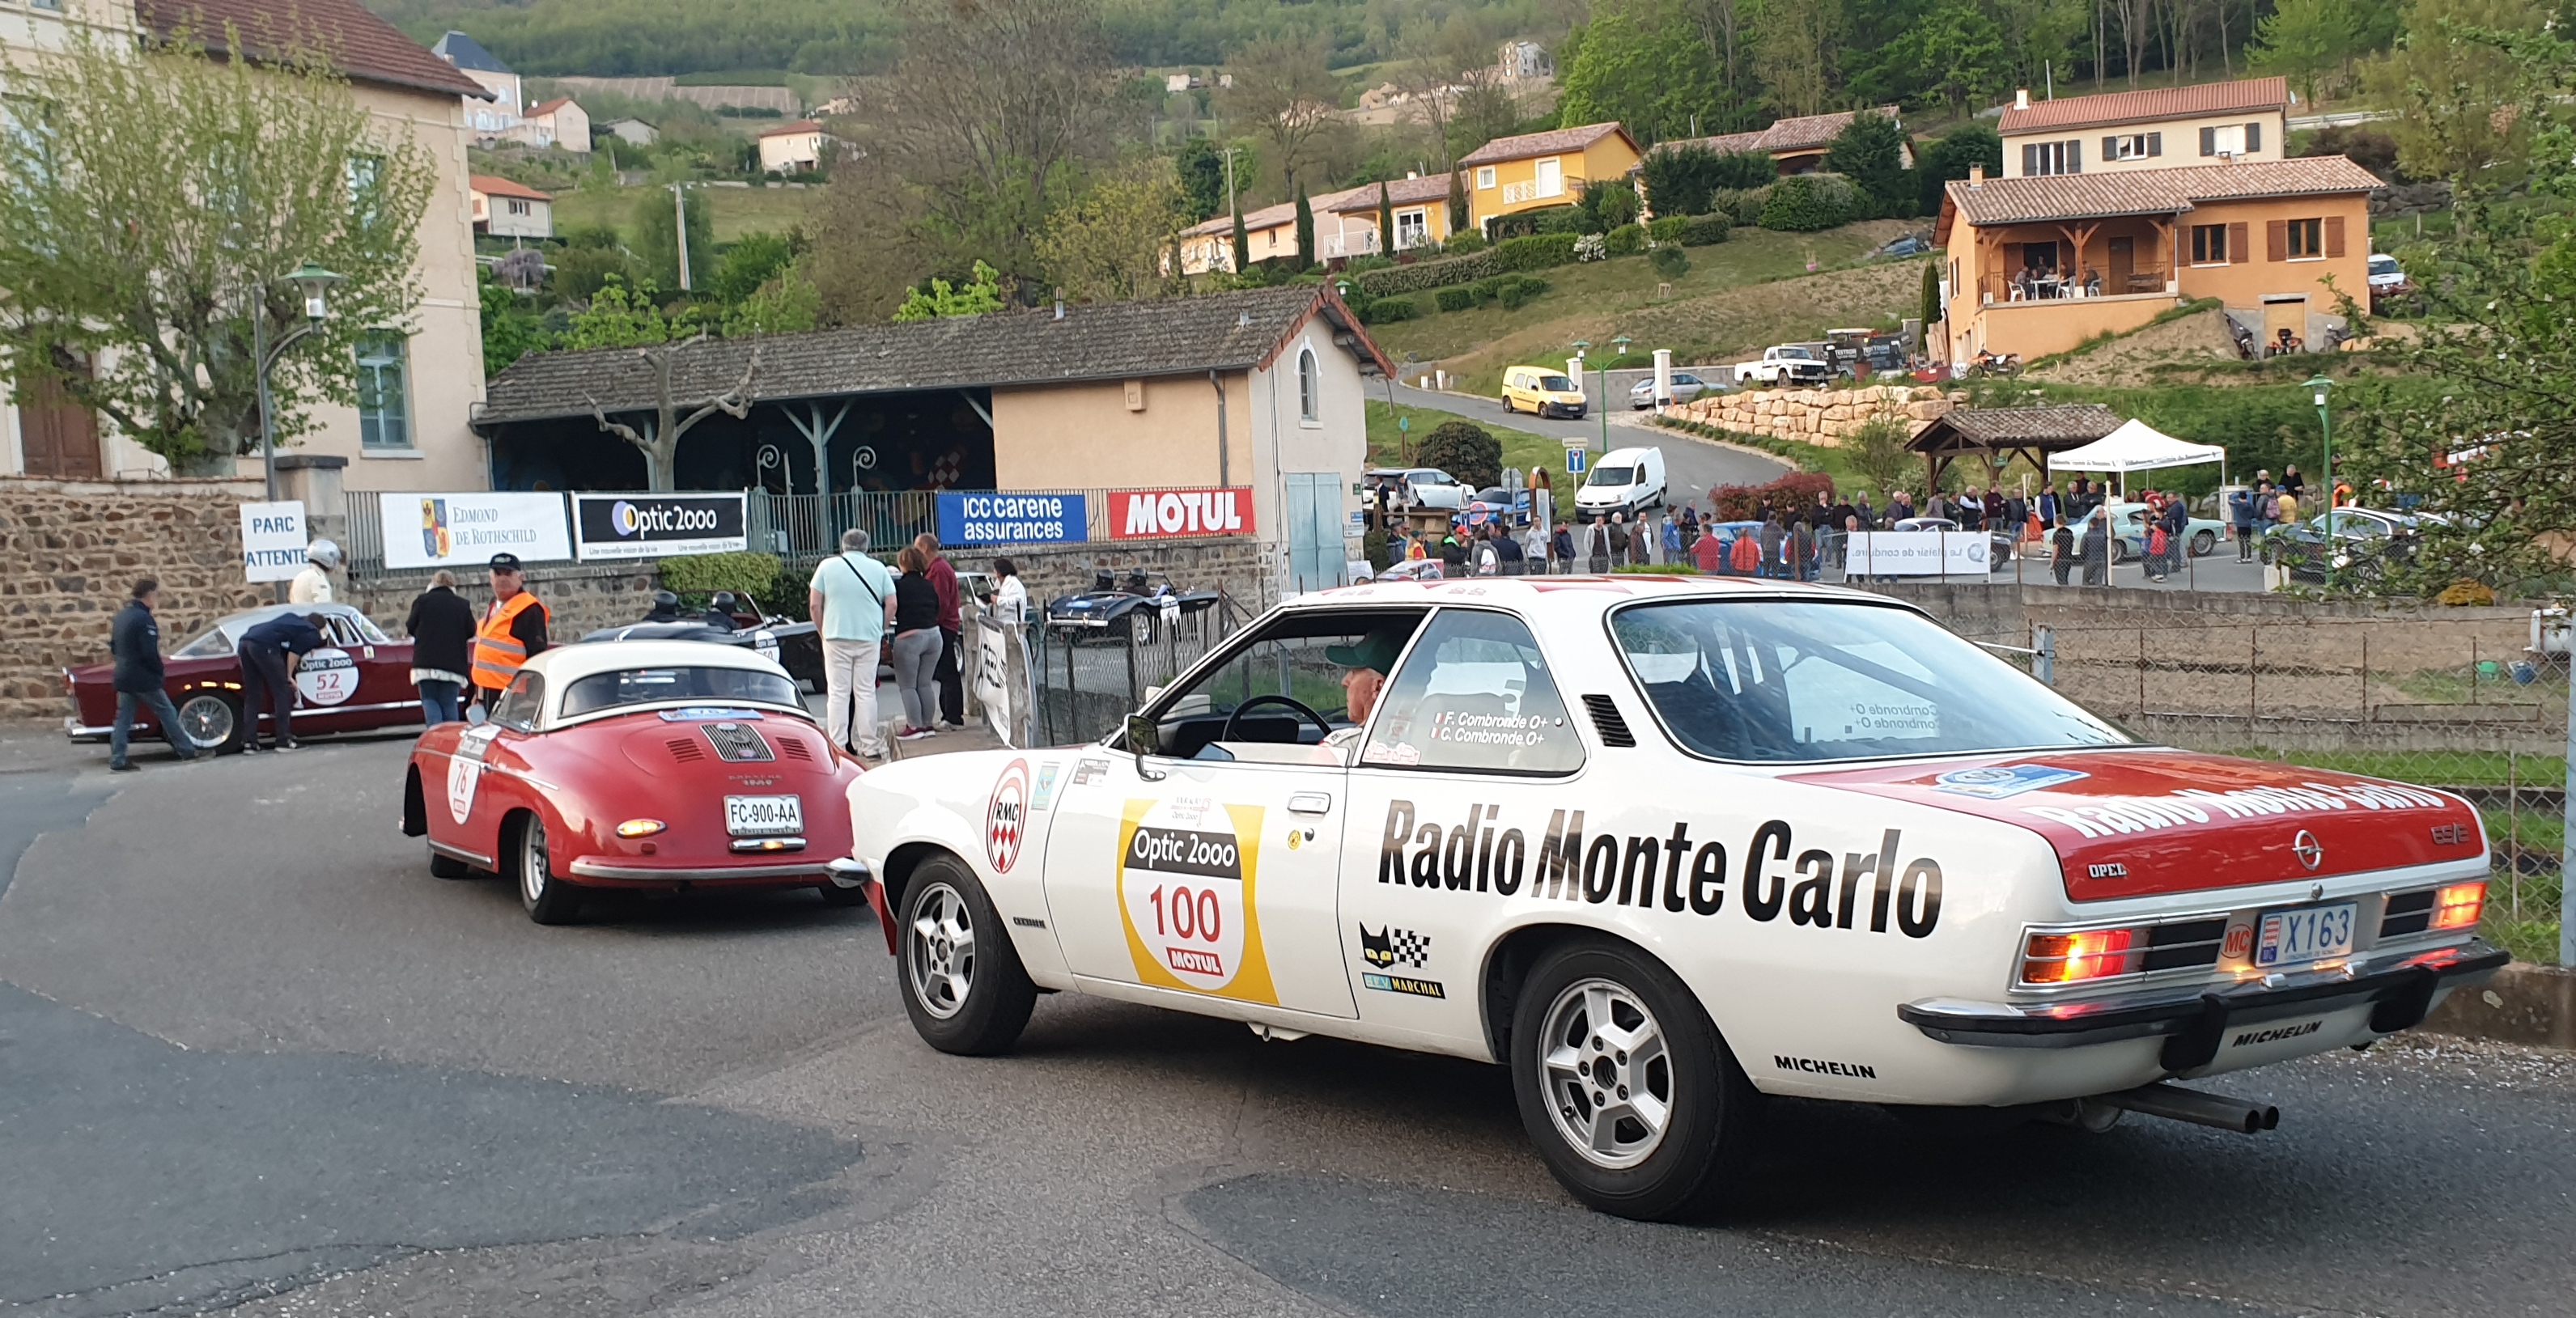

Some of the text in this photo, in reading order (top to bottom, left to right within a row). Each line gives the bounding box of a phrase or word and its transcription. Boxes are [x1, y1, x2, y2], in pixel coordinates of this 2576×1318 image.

[453, 507, 498, 523] EDMOND
[963, 497, 1063, 519] ICC carene
[1125, 492, 1241, 535] MOTUL
[253, 516, 295, 534] PARC
[964, 520, 1063, 540] assurances
[456, 528, 537, 545] DE ROTHSCHILD
[246, 548, 309, 566] ATTENTE
[316, 673, 340, 690] 52
[1445, 711, 1548, 730] F. Combronde O+
[1441, 727, 1452, 741] C.
[1526, 731, 1545, 745] O+
[455, 763, 469, 795] 76
[731, 803, 797, 823] FC-900-AA
[995, 802, 1019, 821] RMC
[1135, 829, 1236, 868] Optic 2000
[1378, 799, 1944, 939] Radio Monte Carlo
[2088, 862, 2127, 878] OPEL
[1150, 884, 1220, 943] 100
[2226, 930, 2250, 953] MC
[2284, 909, 2349, 954] X163
[1170, 950, 1220, 973] MOTUL
[1391, 977, 1441, 997] MARCHAL
[2232, 1020, 2323, 1048] MICHELIN
[1774, 1054, 1877, 1079] MICHELIN
